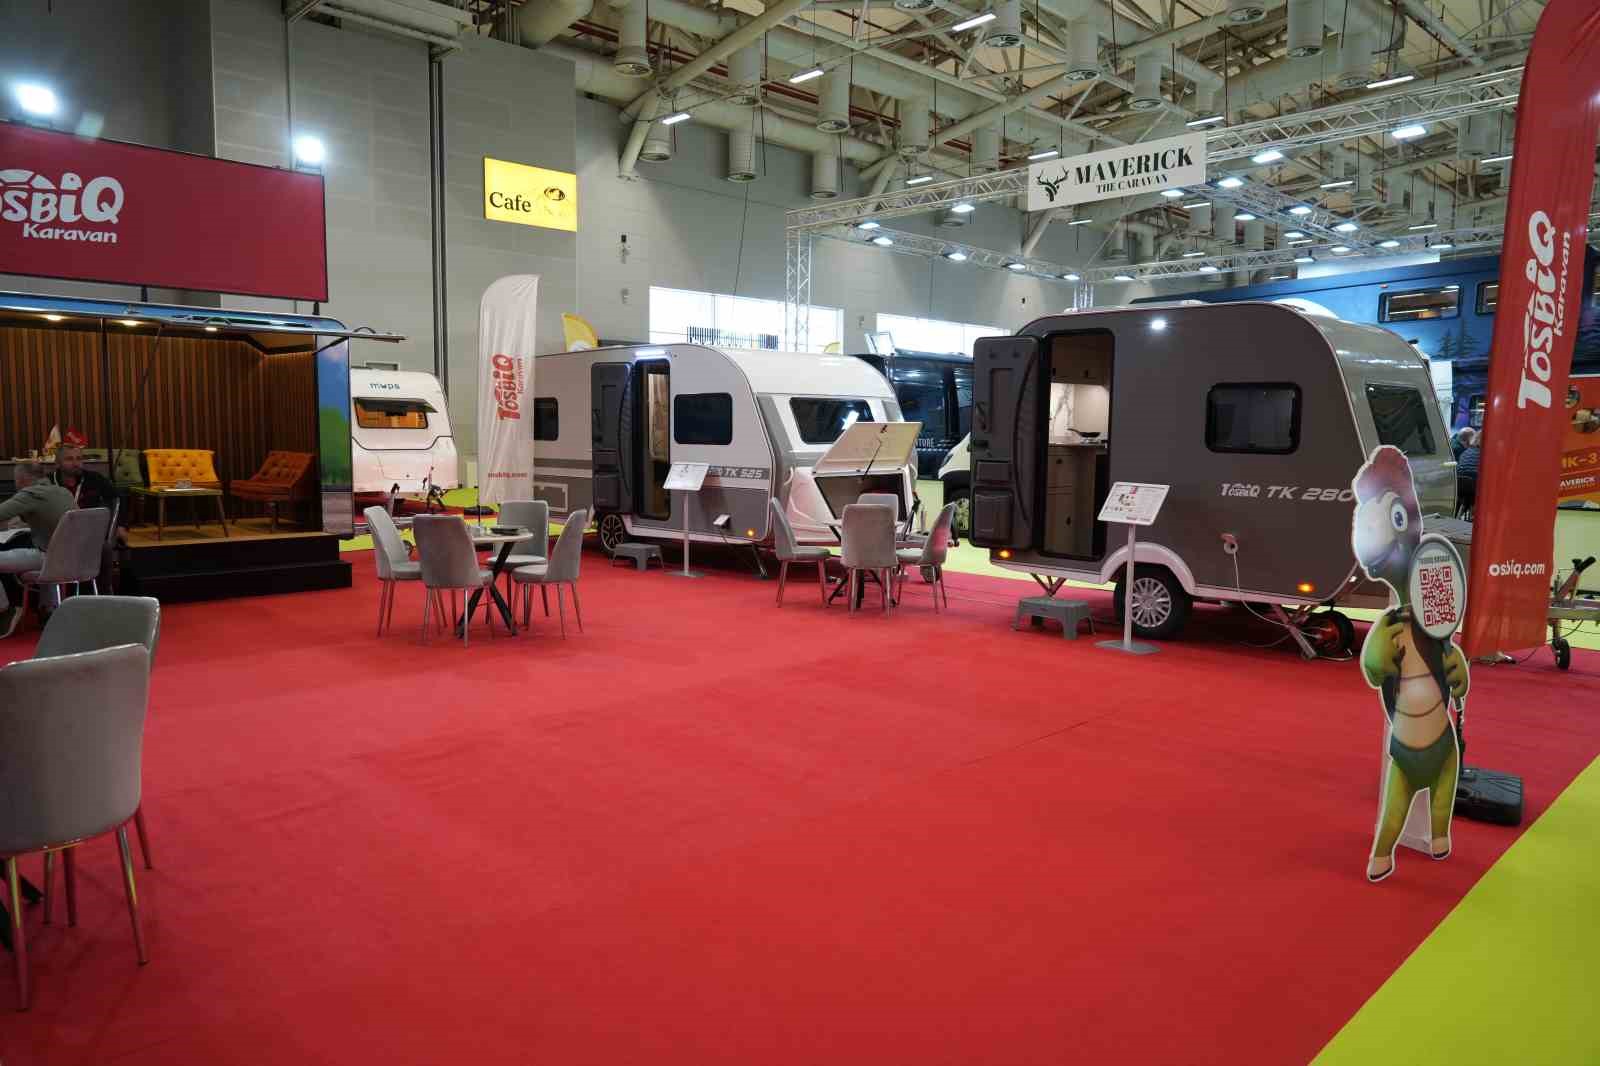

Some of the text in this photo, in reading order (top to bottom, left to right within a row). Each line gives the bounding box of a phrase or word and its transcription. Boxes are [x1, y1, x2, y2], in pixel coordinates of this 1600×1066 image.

[1075, 146, 1192, 184] MAVERICK
[1096, 174, 1168, 193] THE CARAVAN
[489, 190, 532, 213] Cafe
[23, 222, 117, 242] Karavan
[1553, 231, 1571, 336] Karavan
[1266, 486, 1297, 499] TK
[1302, 488, 1354, 502] 280
